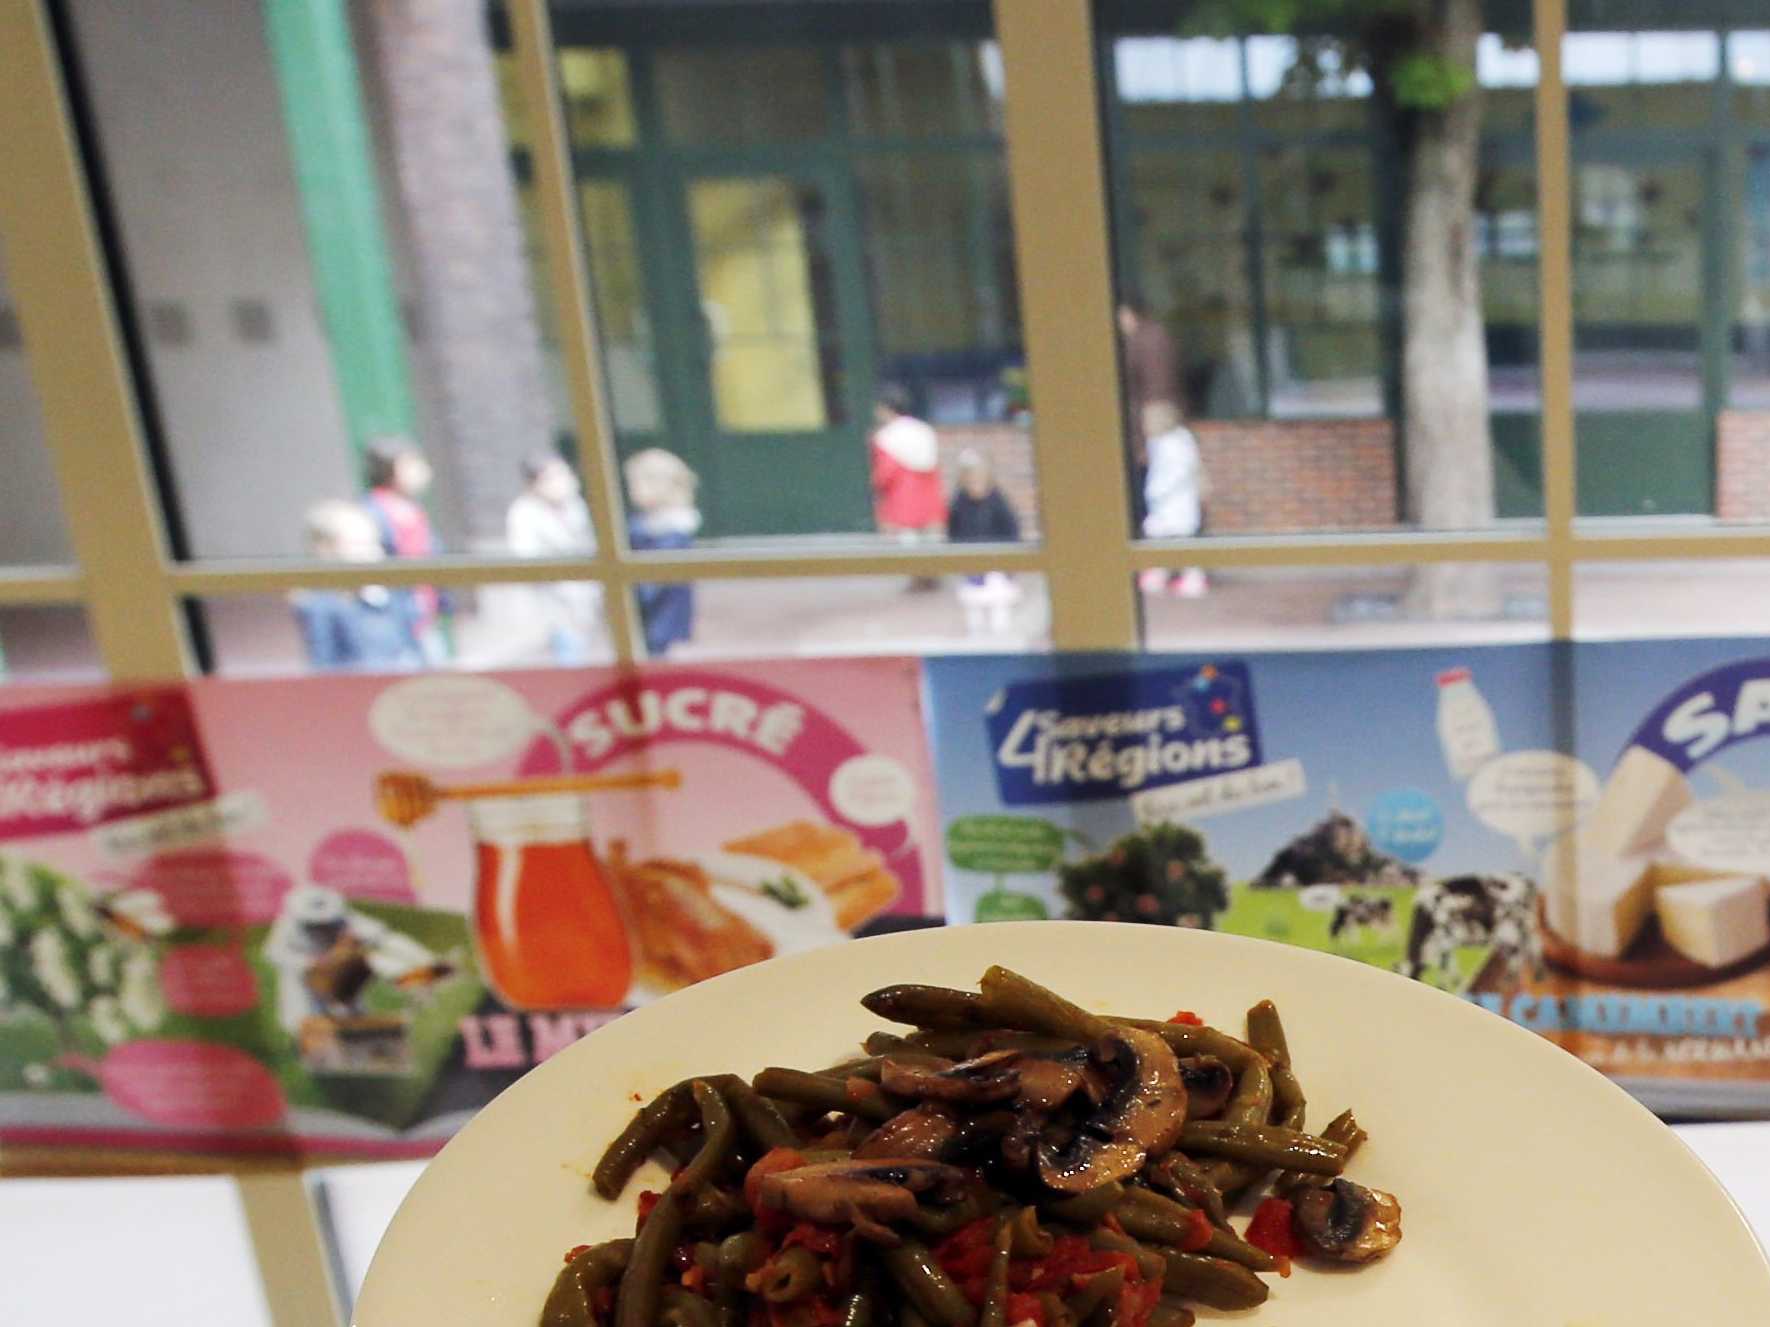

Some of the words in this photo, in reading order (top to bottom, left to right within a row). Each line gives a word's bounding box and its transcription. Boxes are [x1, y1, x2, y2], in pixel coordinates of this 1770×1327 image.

[998, 708, 1048, 785] 4
[1037, 704, 1187, 740] Saveurs
[1049, 732, 1252, 789] Régions
